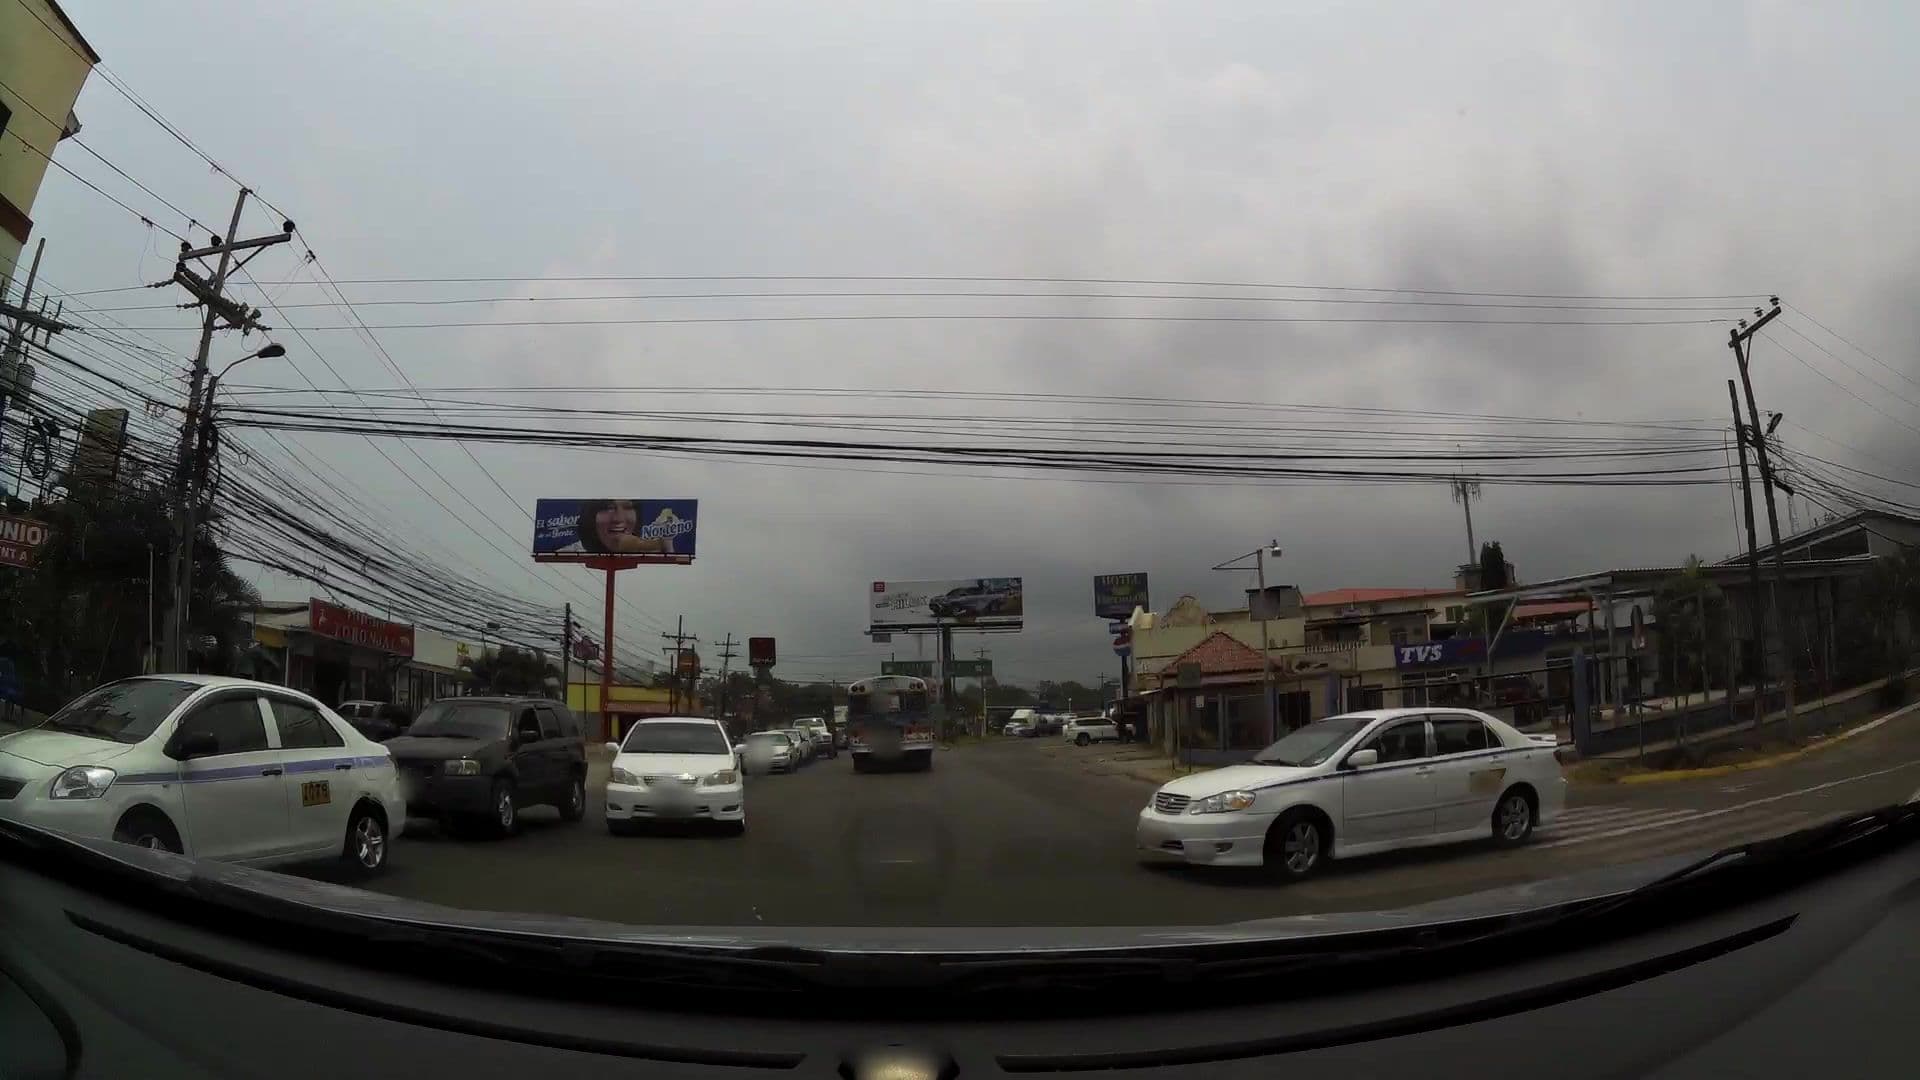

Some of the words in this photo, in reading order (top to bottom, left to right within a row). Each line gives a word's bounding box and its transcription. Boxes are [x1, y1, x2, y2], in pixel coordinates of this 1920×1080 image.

[547, 513, 580, 528] sabor
[1102, 574, 1142, 585] HOTEL
[1401, 644, 1443, 664] TVS
